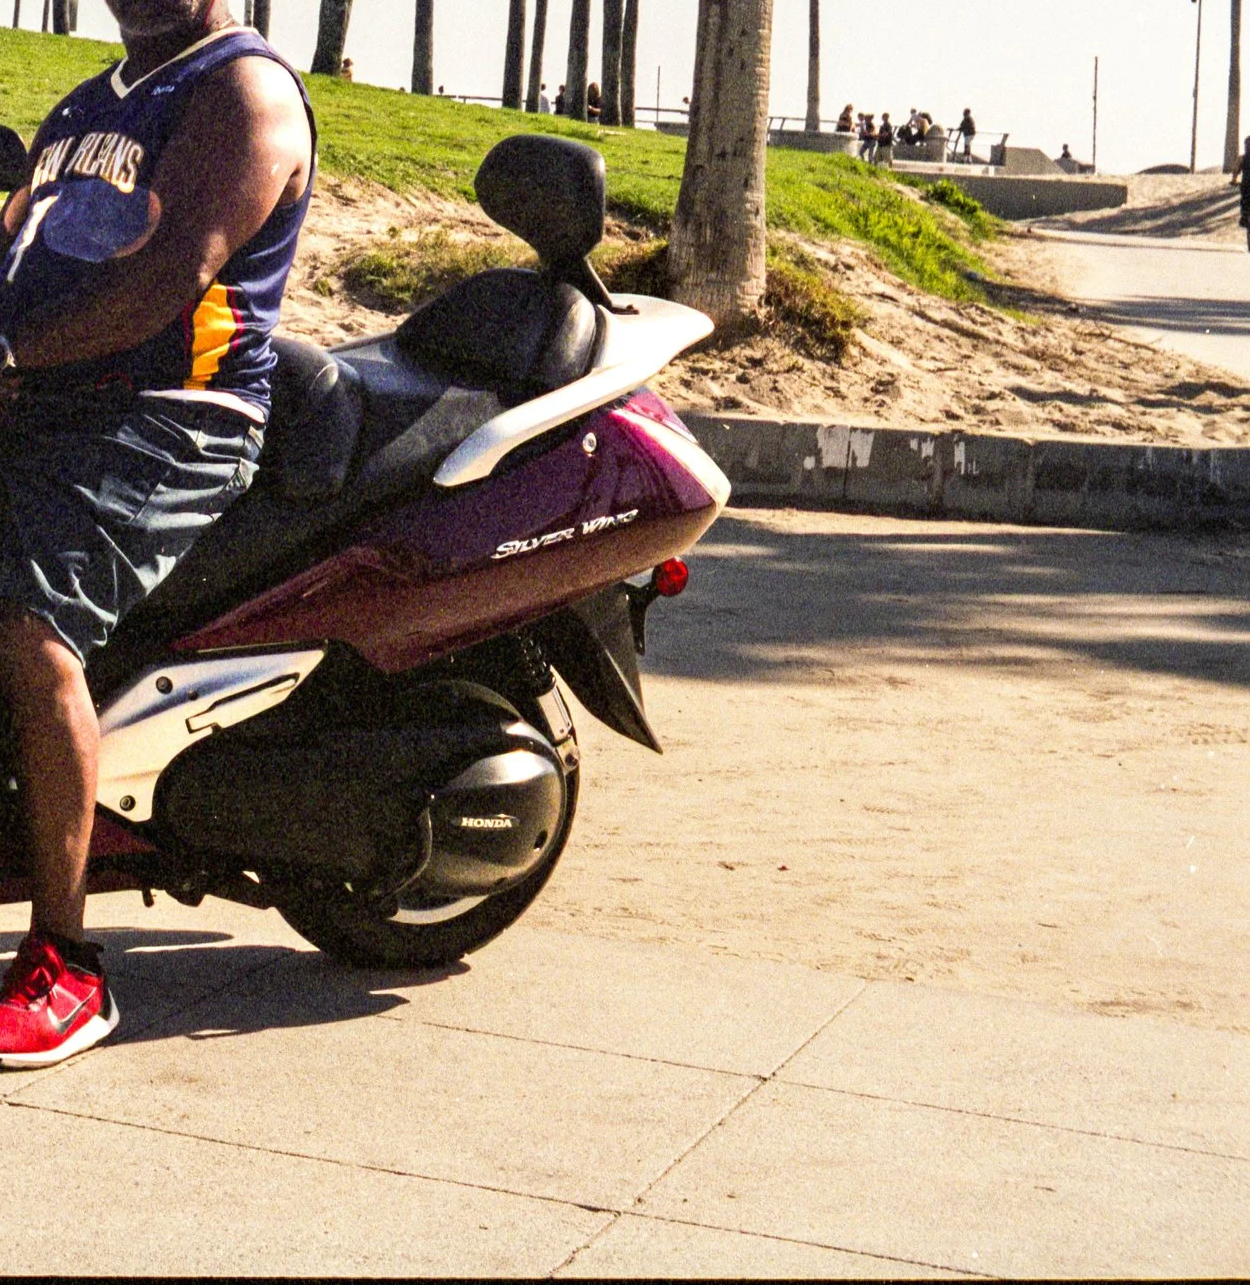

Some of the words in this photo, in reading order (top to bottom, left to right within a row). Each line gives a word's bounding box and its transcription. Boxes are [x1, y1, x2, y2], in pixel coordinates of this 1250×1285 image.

[490, 527, 575, 560] SILVER
[582, 508, 639, 536] WING
[460, 817, 513, 828] HONDA
